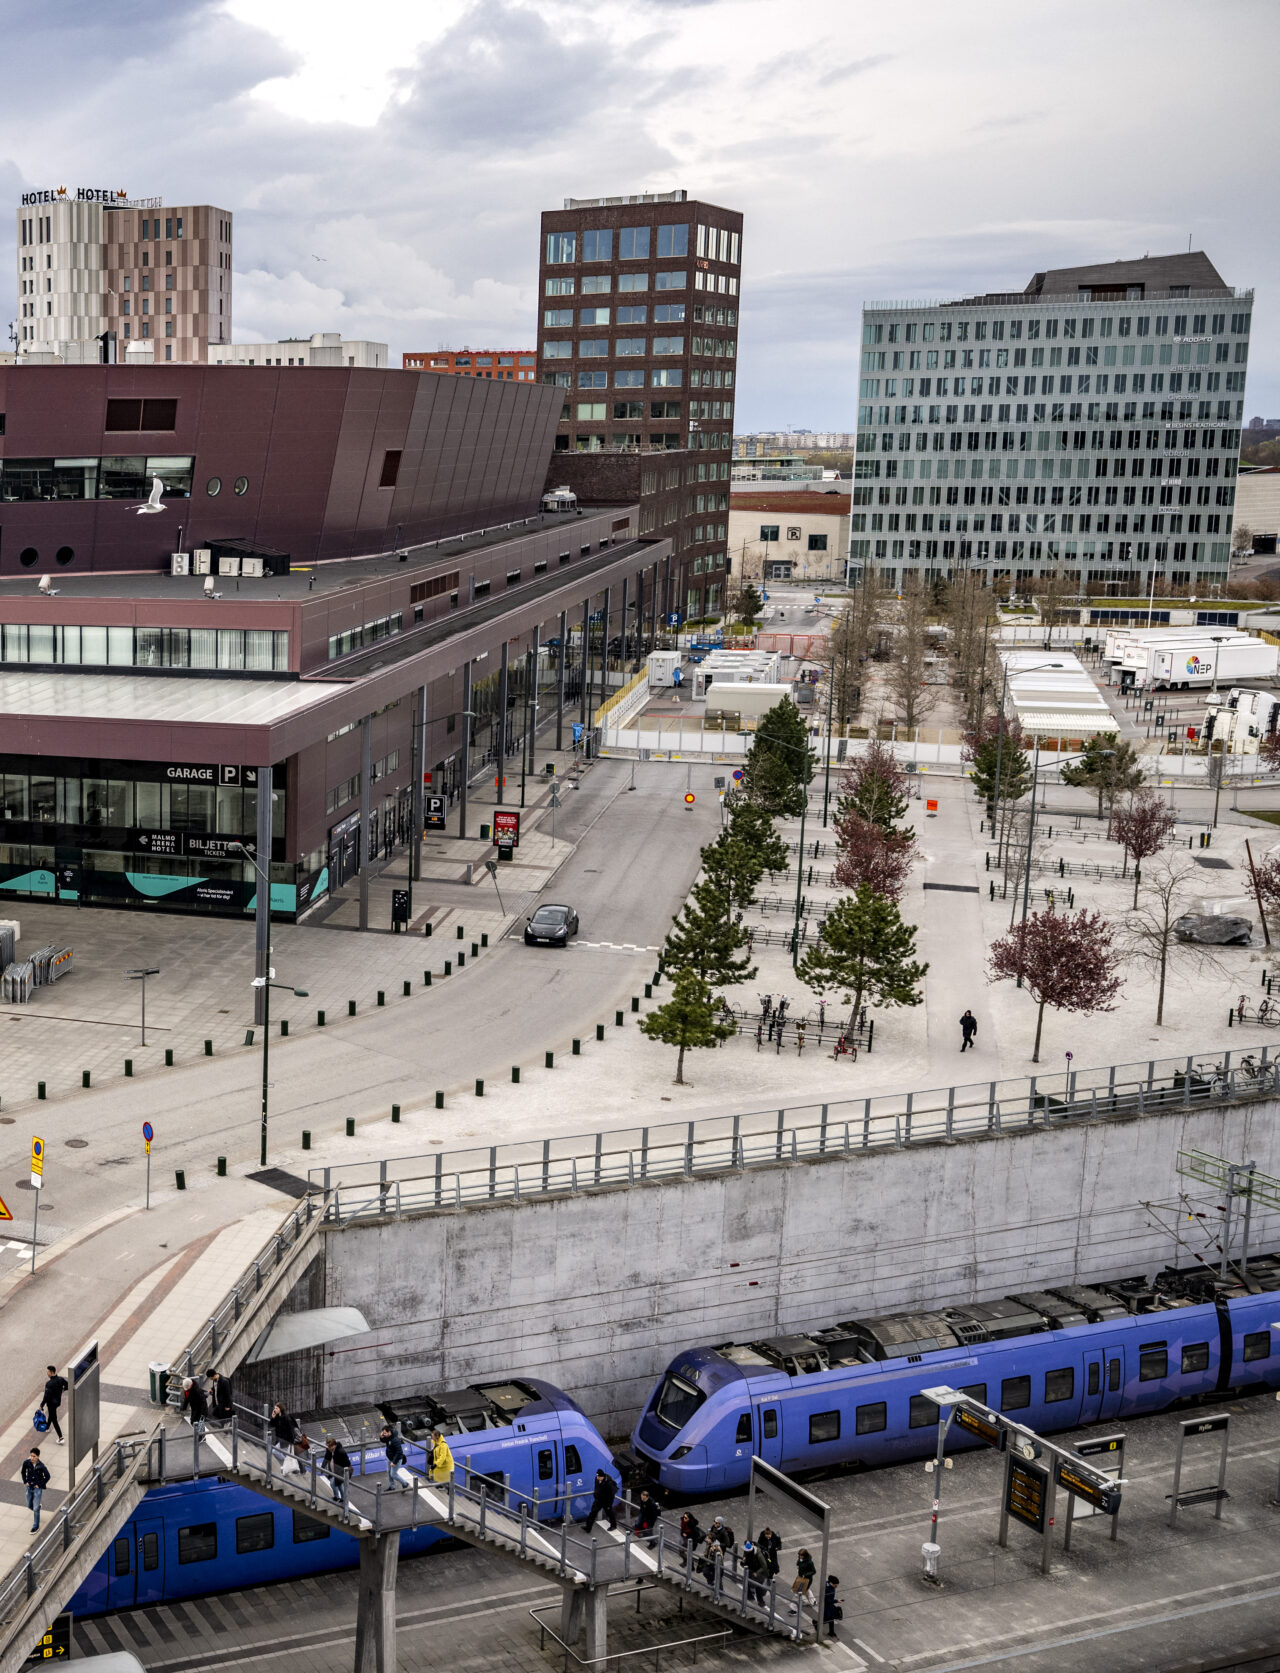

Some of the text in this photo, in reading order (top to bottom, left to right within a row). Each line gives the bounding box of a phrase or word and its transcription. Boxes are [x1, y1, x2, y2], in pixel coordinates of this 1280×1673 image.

[22, 189, 56, 205] HOTEL
[77, 187, 116, 203] HOTEL
[1193, 663, 1212, 675] NEP
[167, 766, 236, 782] GARAGE P
[430, 798, 441, 812] P
[189, 839, 241, 851] BILJETT
[204, 849, 226, 857] TICKETS
[1198, 1423, 1213, 1432] Hyllie
